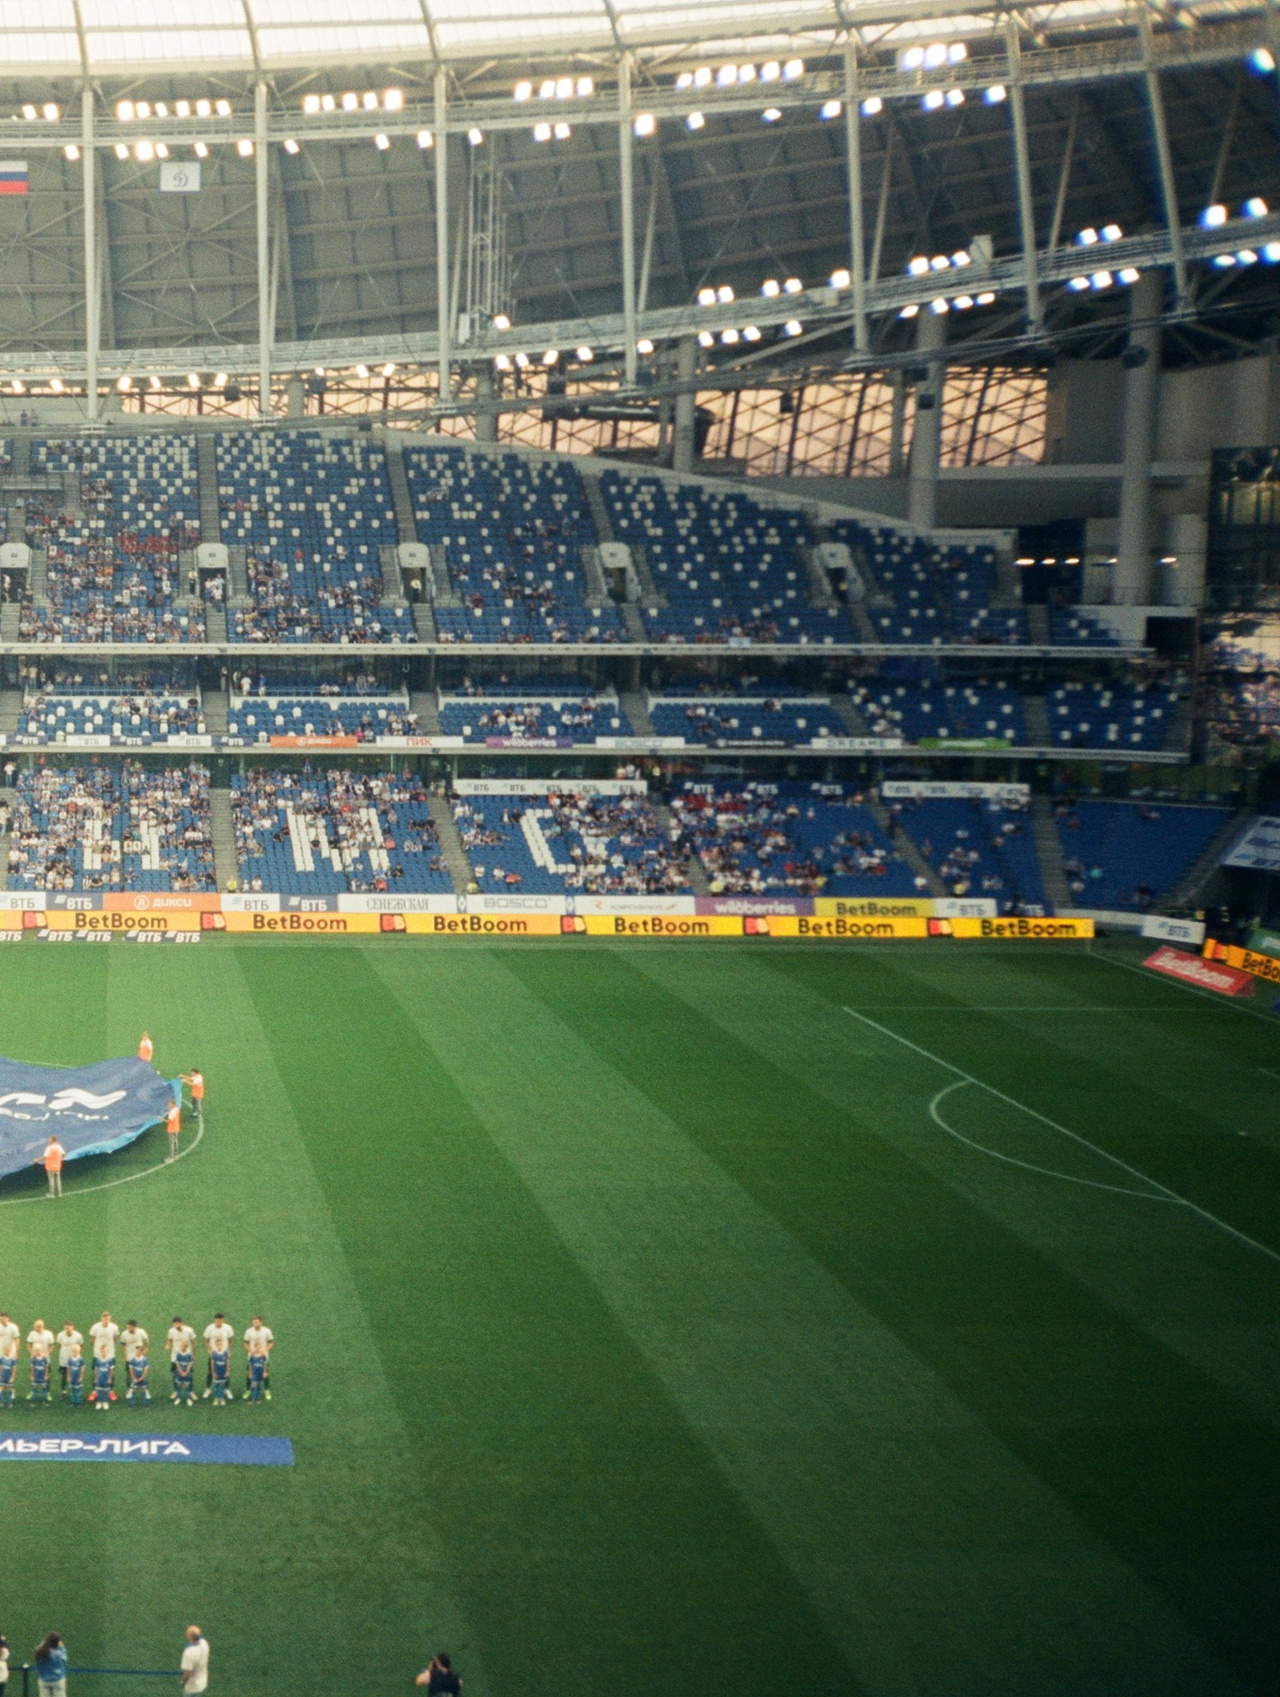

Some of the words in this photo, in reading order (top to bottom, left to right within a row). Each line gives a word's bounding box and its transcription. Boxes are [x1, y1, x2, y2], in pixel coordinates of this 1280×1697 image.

[406, 737, 433, 746] ПИК
[11, 897, 35, 908] ВТБ
[67, 897, 92, 910] ВТБ
[244, 900, 269, 911] ВТБ
[301, 900, 327, 912] ВТБ
[484, 898, 547, 909] BOSCO
[715, 901, 797, 915] wildberries
[836, 902, 917, 916] BetBoom
[75, 913, 168, 929] BetBoom
[253, 914, 347, 930] BetBoom
[434, 916, 527, 932] BetBoom
[614, 917, 709, 933] BetBoom
[798, 918, 894, 935] BetBoom
[981, 919, 1077, 935] BetBoom
[48, 931, 73, 941] ВТБ
[86, 931, 112, 942] ВТБ
[137, 931, 162, 942] ВТБ
[175, 931, 200, 943] ВТБ
